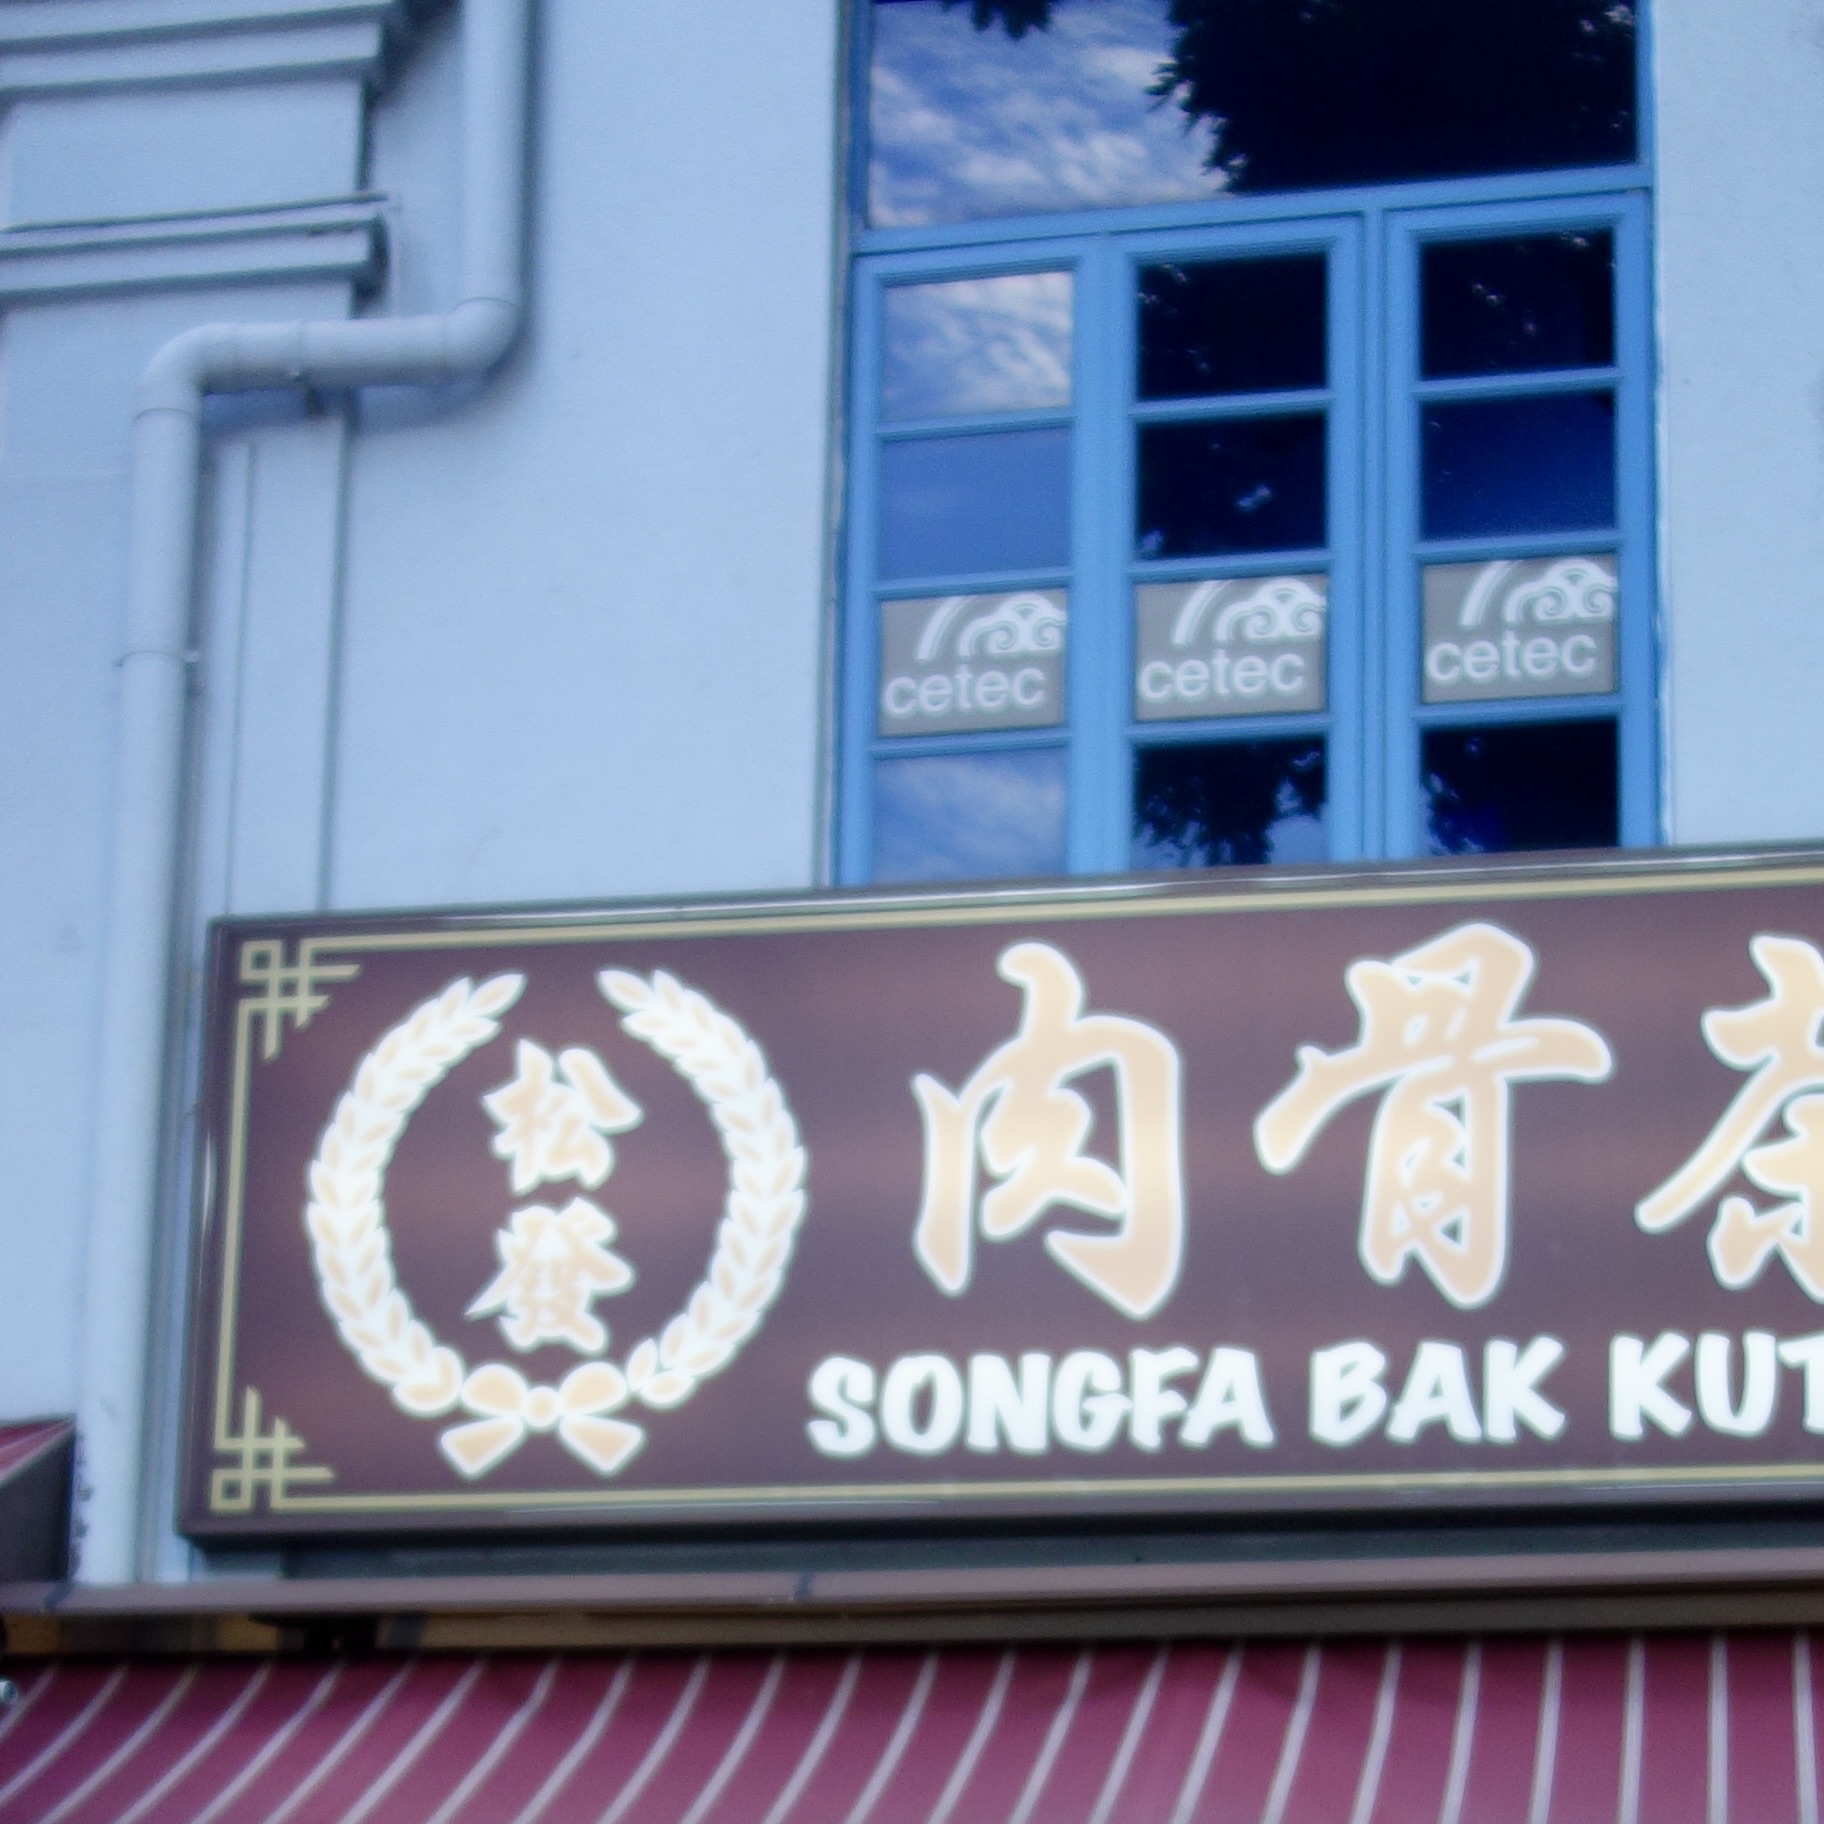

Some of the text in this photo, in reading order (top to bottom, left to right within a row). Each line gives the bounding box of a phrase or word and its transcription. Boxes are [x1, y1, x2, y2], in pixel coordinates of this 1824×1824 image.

[1139, 648, 1306, 703] cetec
[1426, 630, 1597, 683] cetec
[884, 662, 1046, 718] cetec
[808, 1345, 1275, 1460] SONGFA
[1309, 1333, 1566, 1447] BAK
